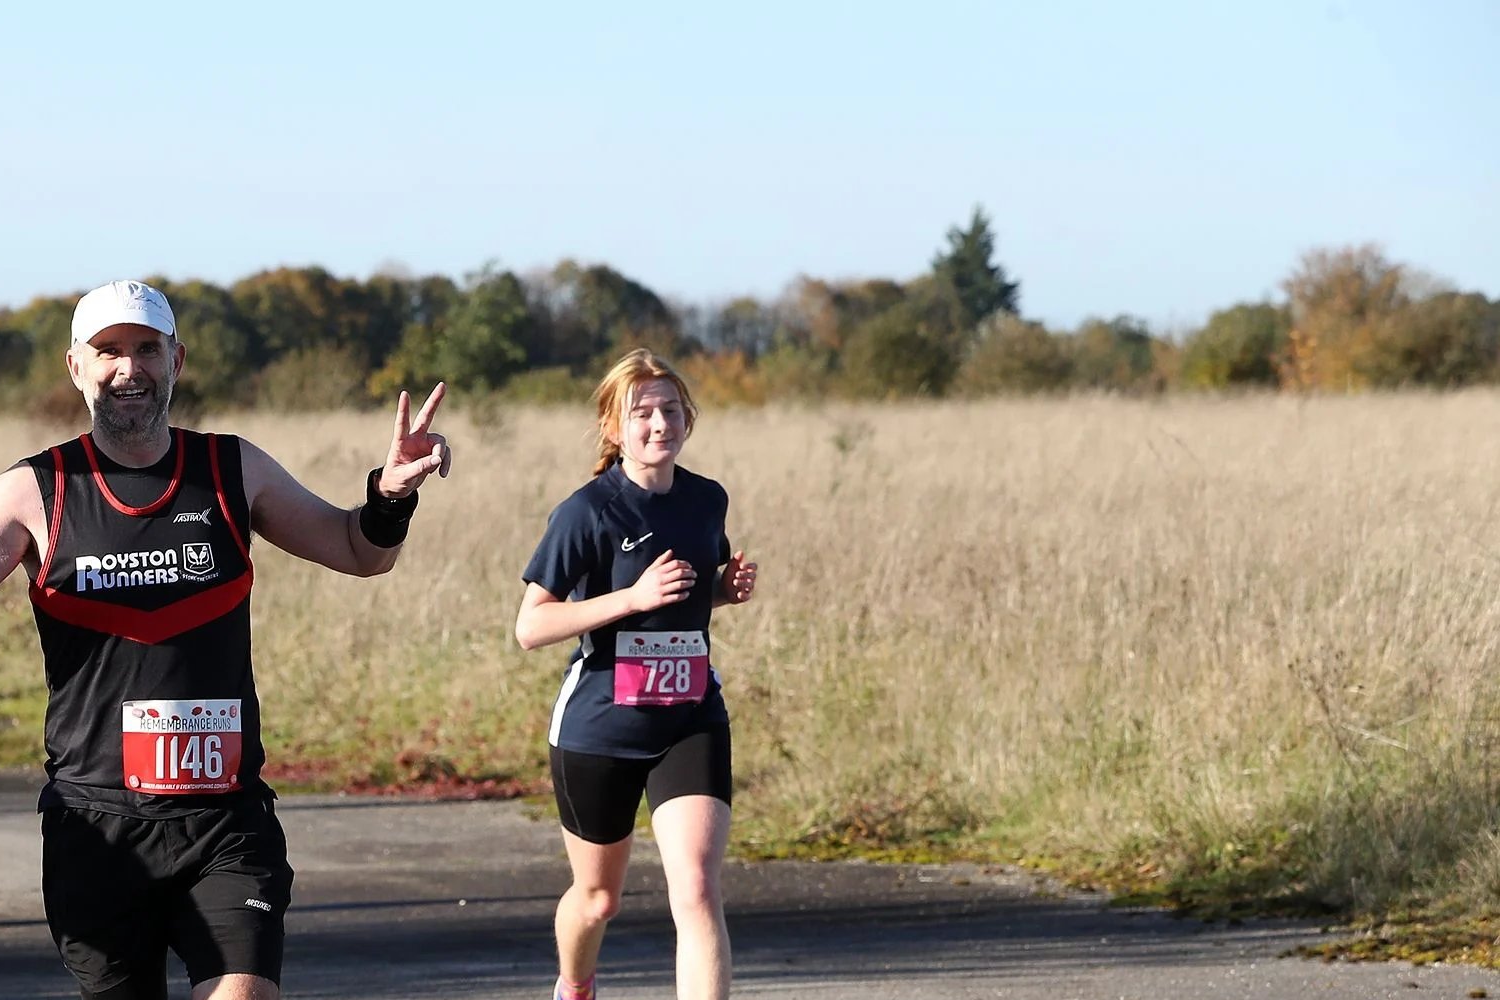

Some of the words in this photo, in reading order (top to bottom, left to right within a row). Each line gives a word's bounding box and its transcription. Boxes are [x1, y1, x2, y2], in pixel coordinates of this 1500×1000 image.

[75, 549, 178, 577] ROYSTON
[76, 566, 180, 592] RUNNERS
[643, 660, 690, 693] 728
[141, 718, 211, 730] REMEMBRANCE
[213, 717, 231, 730] RUNS
[156, 735, 222, 779] 1146
